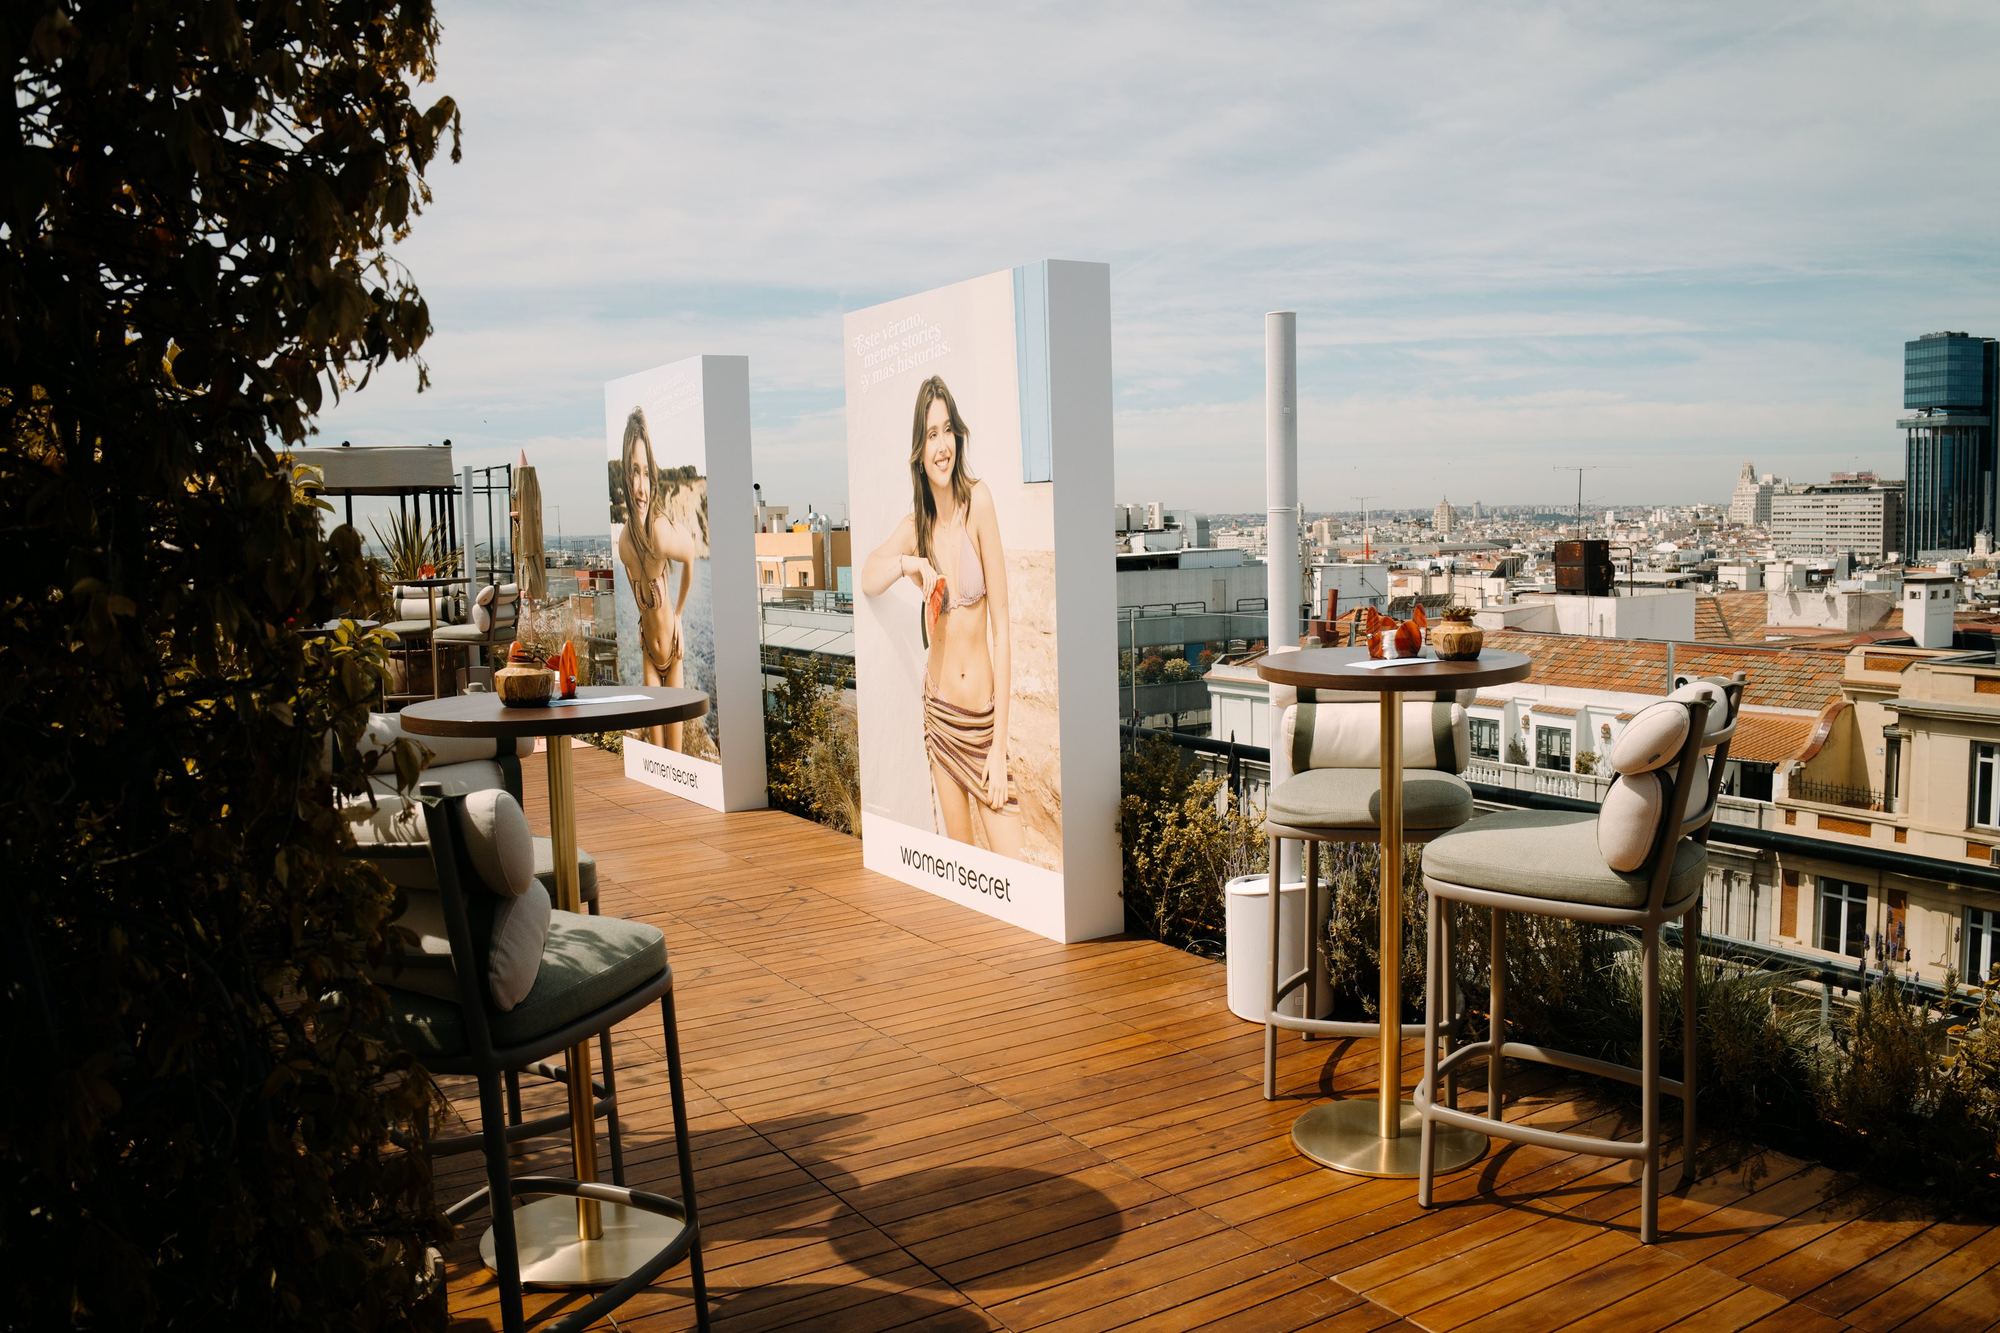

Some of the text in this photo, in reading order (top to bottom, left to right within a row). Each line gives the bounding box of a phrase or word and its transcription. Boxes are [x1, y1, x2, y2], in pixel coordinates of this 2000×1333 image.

[864, 322, 942, 368] menos stories
[642, 757, 698, 789] women'secret
[900, 845, 1011, 902] women'secret
